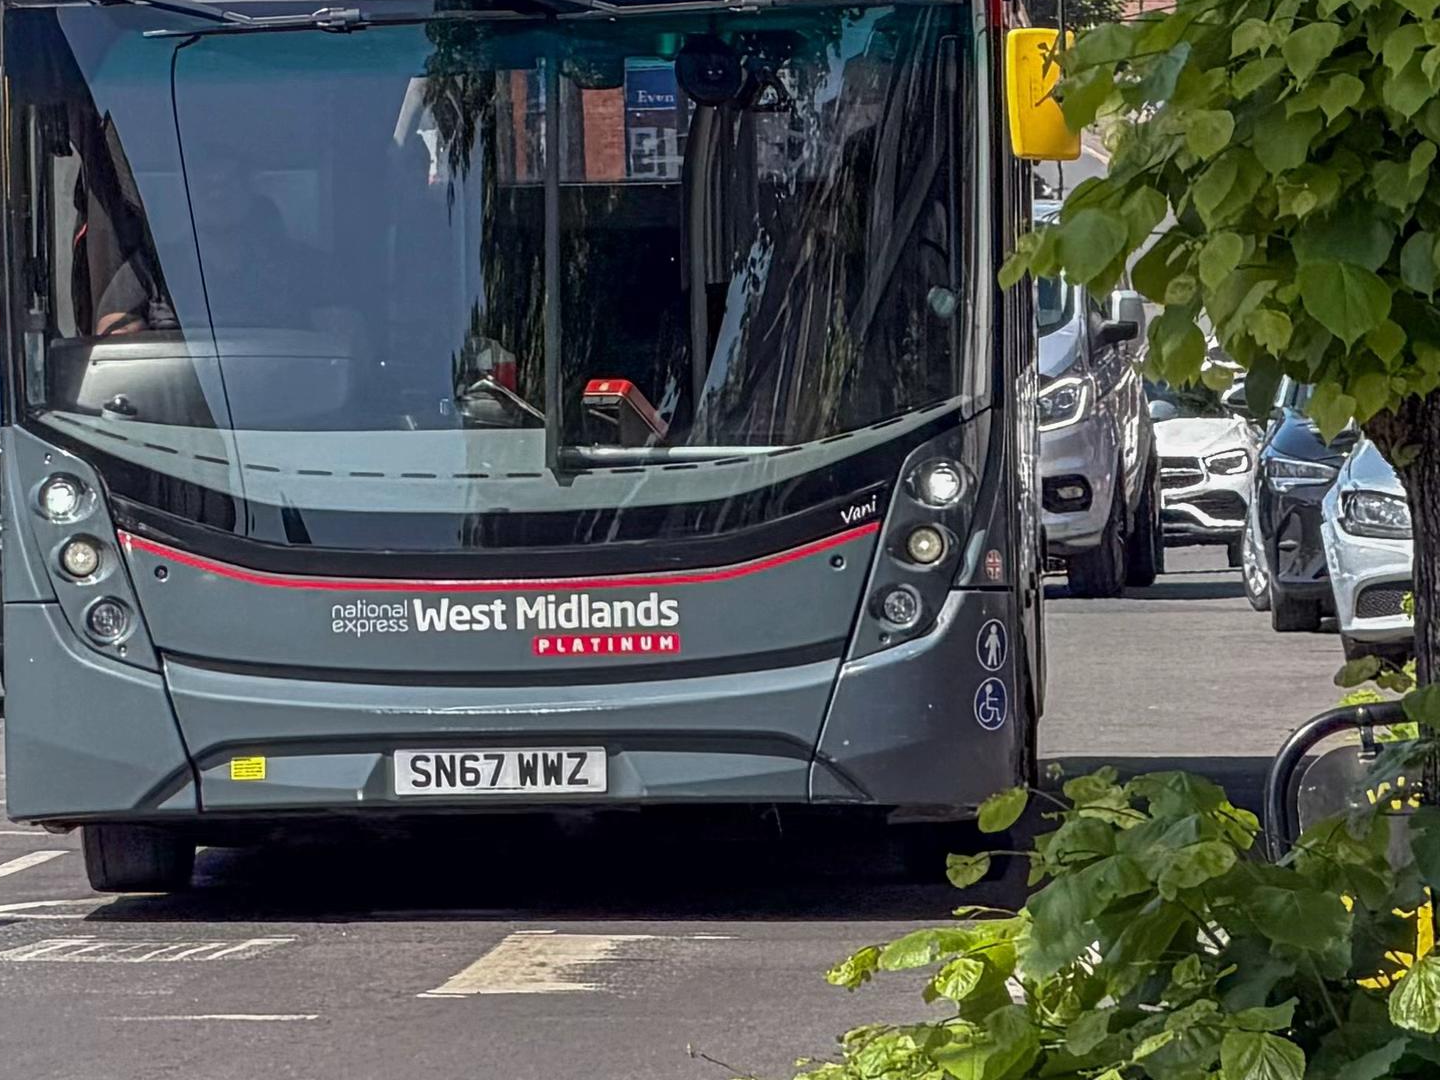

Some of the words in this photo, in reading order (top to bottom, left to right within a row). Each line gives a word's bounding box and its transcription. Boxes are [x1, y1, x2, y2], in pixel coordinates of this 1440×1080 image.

[840, 494, 878, 525] Vani
[331, 599, 409, 619] national
[412, 597, 508, 633] West
[515, 591, 681, 631] Midlands
[331, 619, 409, 638] express
[537, 635, 675, 654] PLATINUM
[409, 753, 506, 789] SN67
[517, 751, 590, 787] WWZ
